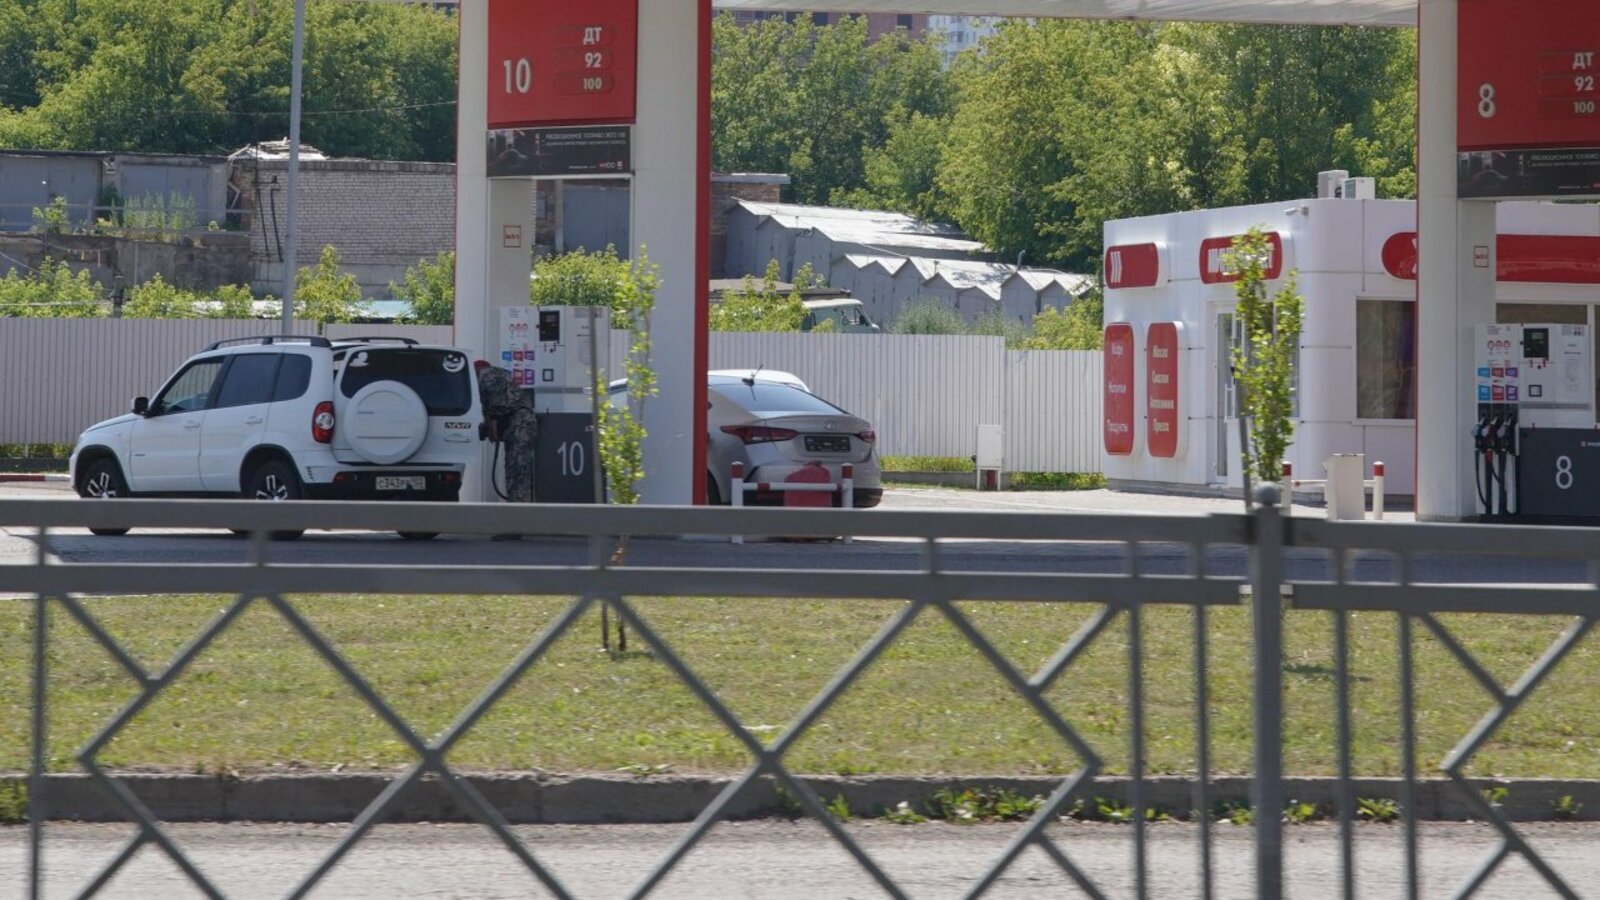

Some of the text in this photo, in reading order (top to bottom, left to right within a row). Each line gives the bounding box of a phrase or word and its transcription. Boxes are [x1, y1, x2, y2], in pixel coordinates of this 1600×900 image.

[583, 26, 602, 45] ДТ
[585, 52, 602, 68] 92
[1573, 52, 1594, 70] ДТ
[503, 58, 531, 94] 10
[583, 77, 602, 90] 100
[1574, 76, 1594, 91] 92
[1478, 83, 1495, 118] 8
[1573, 101, 1595, 114] 100
[557, 441, 584, 476] 10
[1556, 455, 1573, 489] 8
